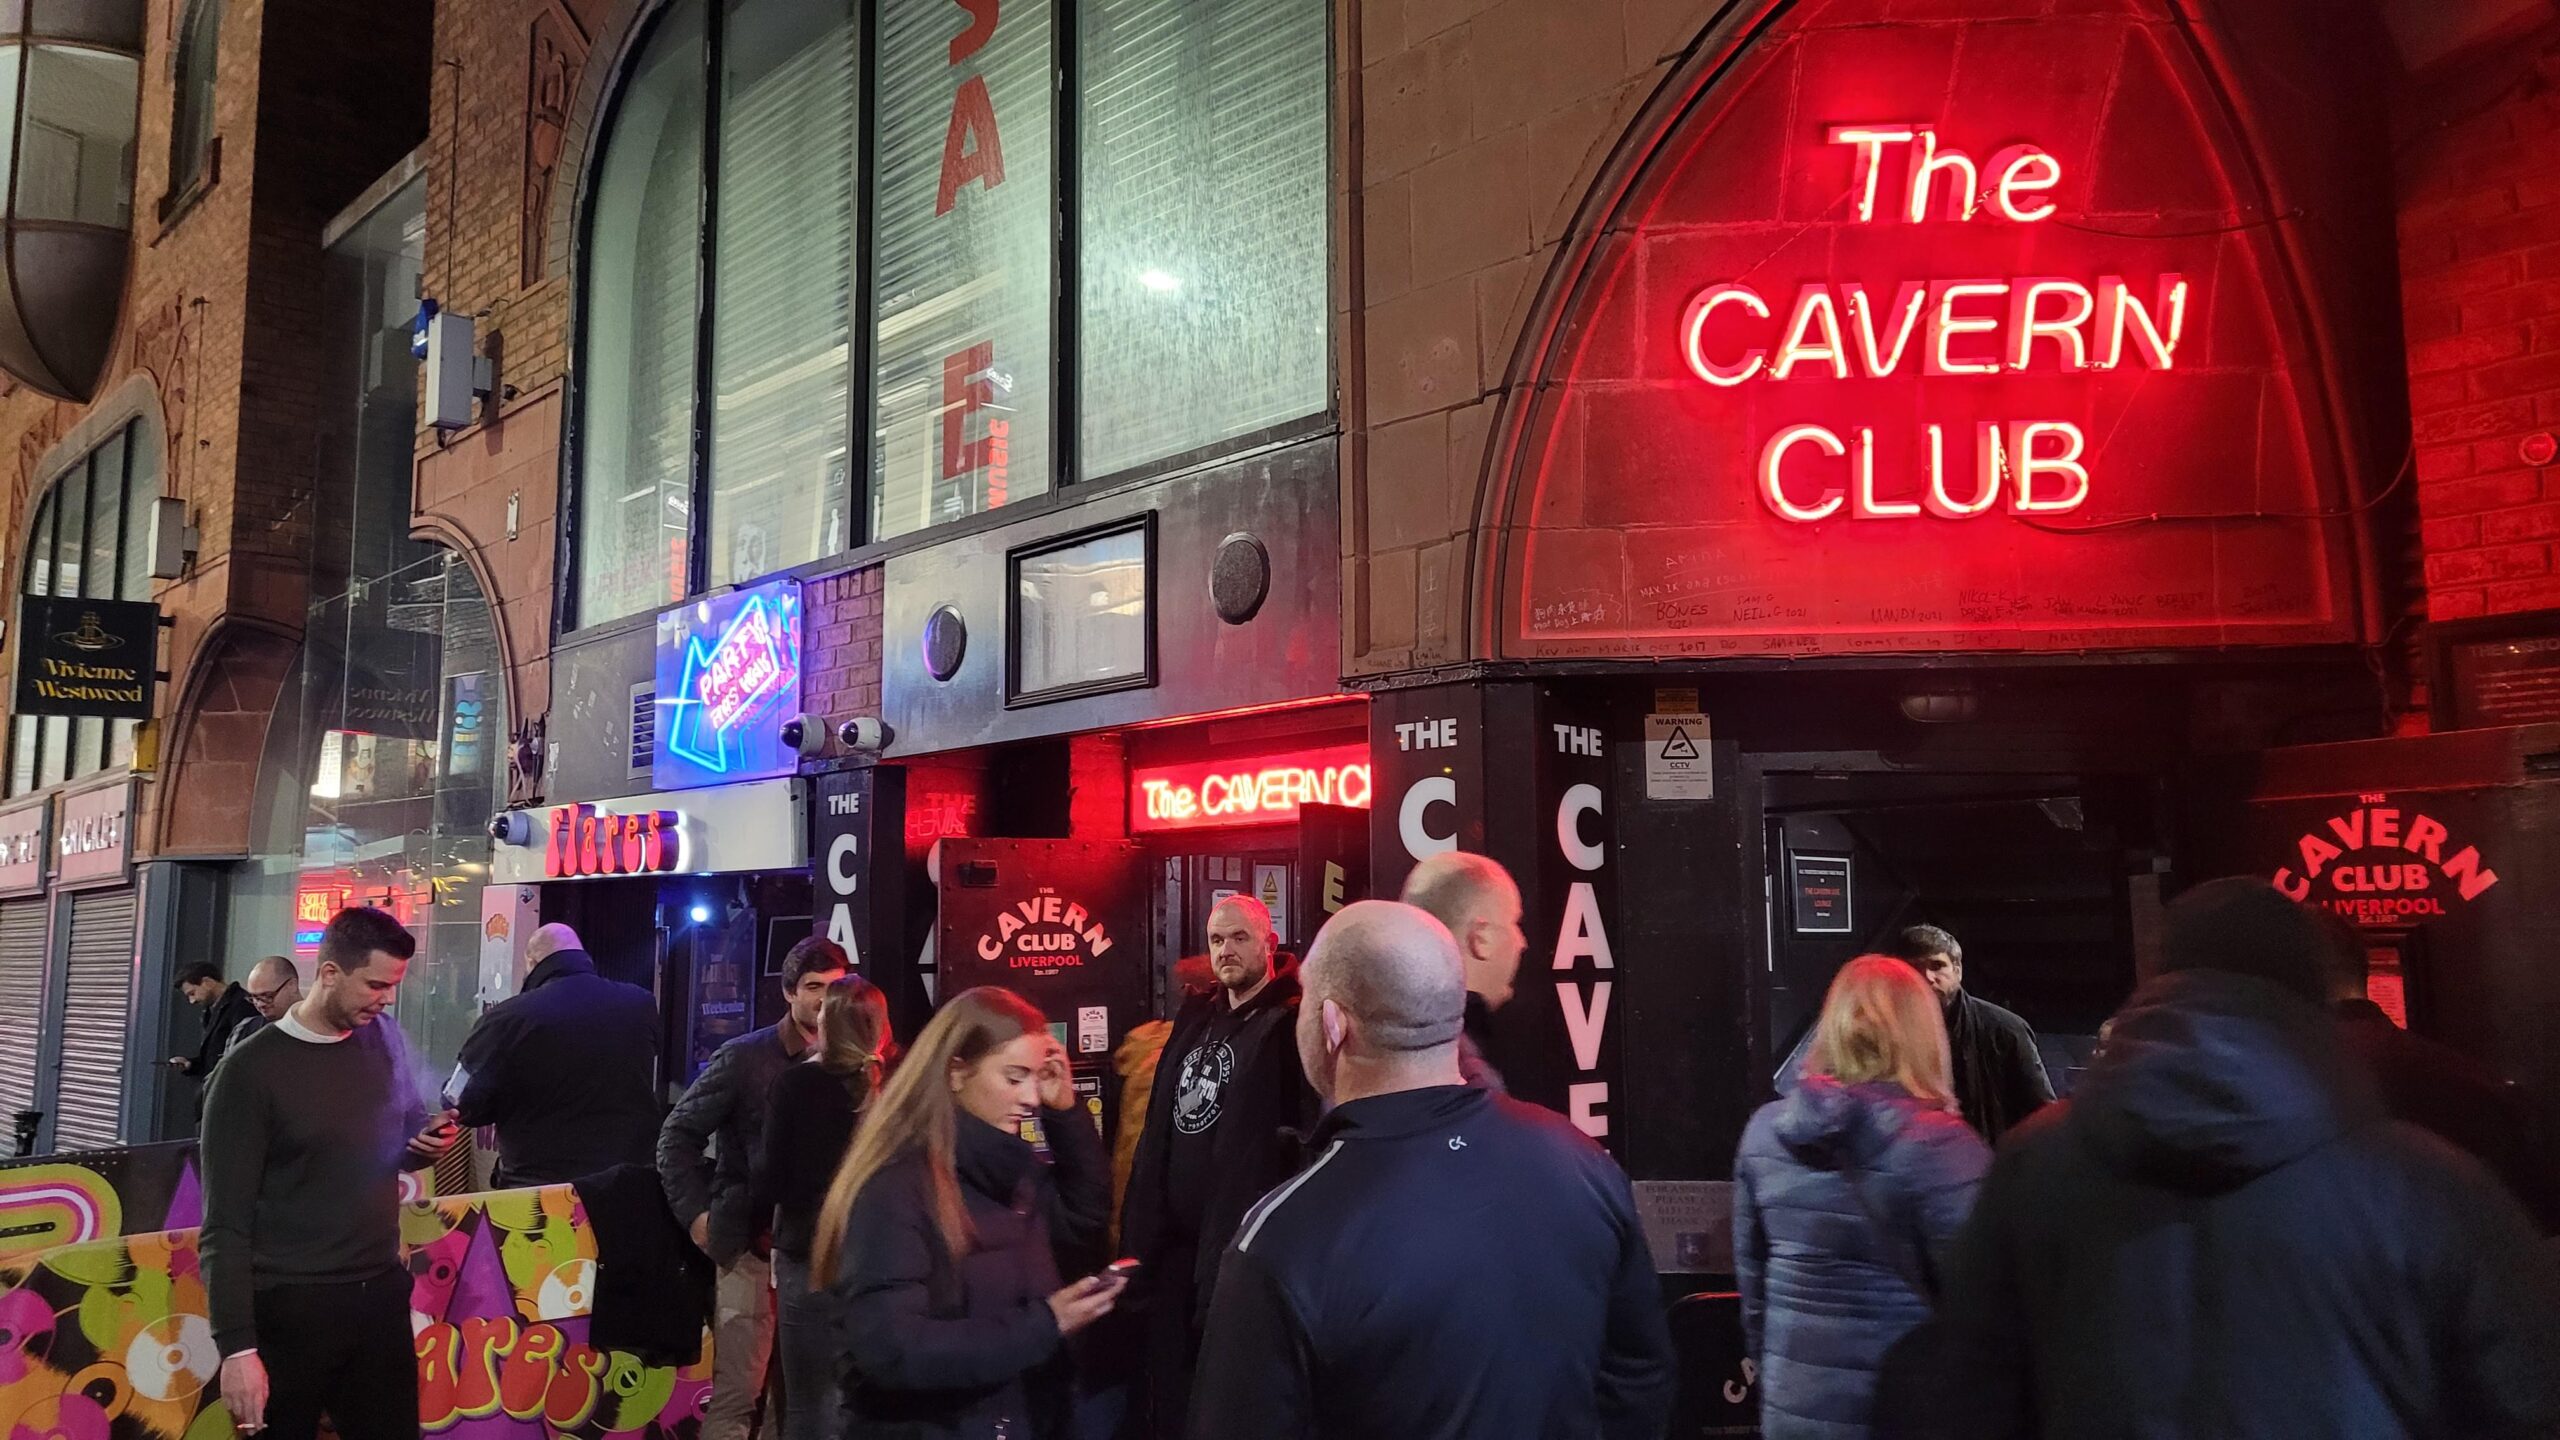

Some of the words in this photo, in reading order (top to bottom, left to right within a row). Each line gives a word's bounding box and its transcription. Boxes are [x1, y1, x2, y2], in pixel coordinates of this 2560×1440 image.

[1830, 124, 2061, 225] The
[1682, 272, 2188, 388] CAVERN
[1760, 420, 2090, 523] CLUB
[1656, 602, 1709, 621] BONES
[42, 657, 137, 681] Vivienne
[699, 611, 769, 706] PARTY
[31, 679, 143, 703] Westwood
[1395, 718, 1458, 752] THE
[1655, 718, 1703, 726] WARNING
[1553, 723, 1603, 757] THE
[828, 793, 860, 816] THE
[1142, 779, 1198, 819] The
[1201, 767, 1337, 817] CAVERN
[2359, 793, 2387, 804] THE
[2273, 808, 2499, 902] CAVERN
[2332, 864, 2430, 892] CLUB
[2323, 897, 2446, 916] IVERPOOL
[978, 896, 1113, 961] CAVERN
[1016, 933, 1077, 952] CLUB
[1009, 955, 1085, 968] LIVERPOOL
[1552, 783, 1614, 1151] CAVE
[1221, 1059, 1231, 1084] 1957
[415, 1316, 612, 1430] ares
